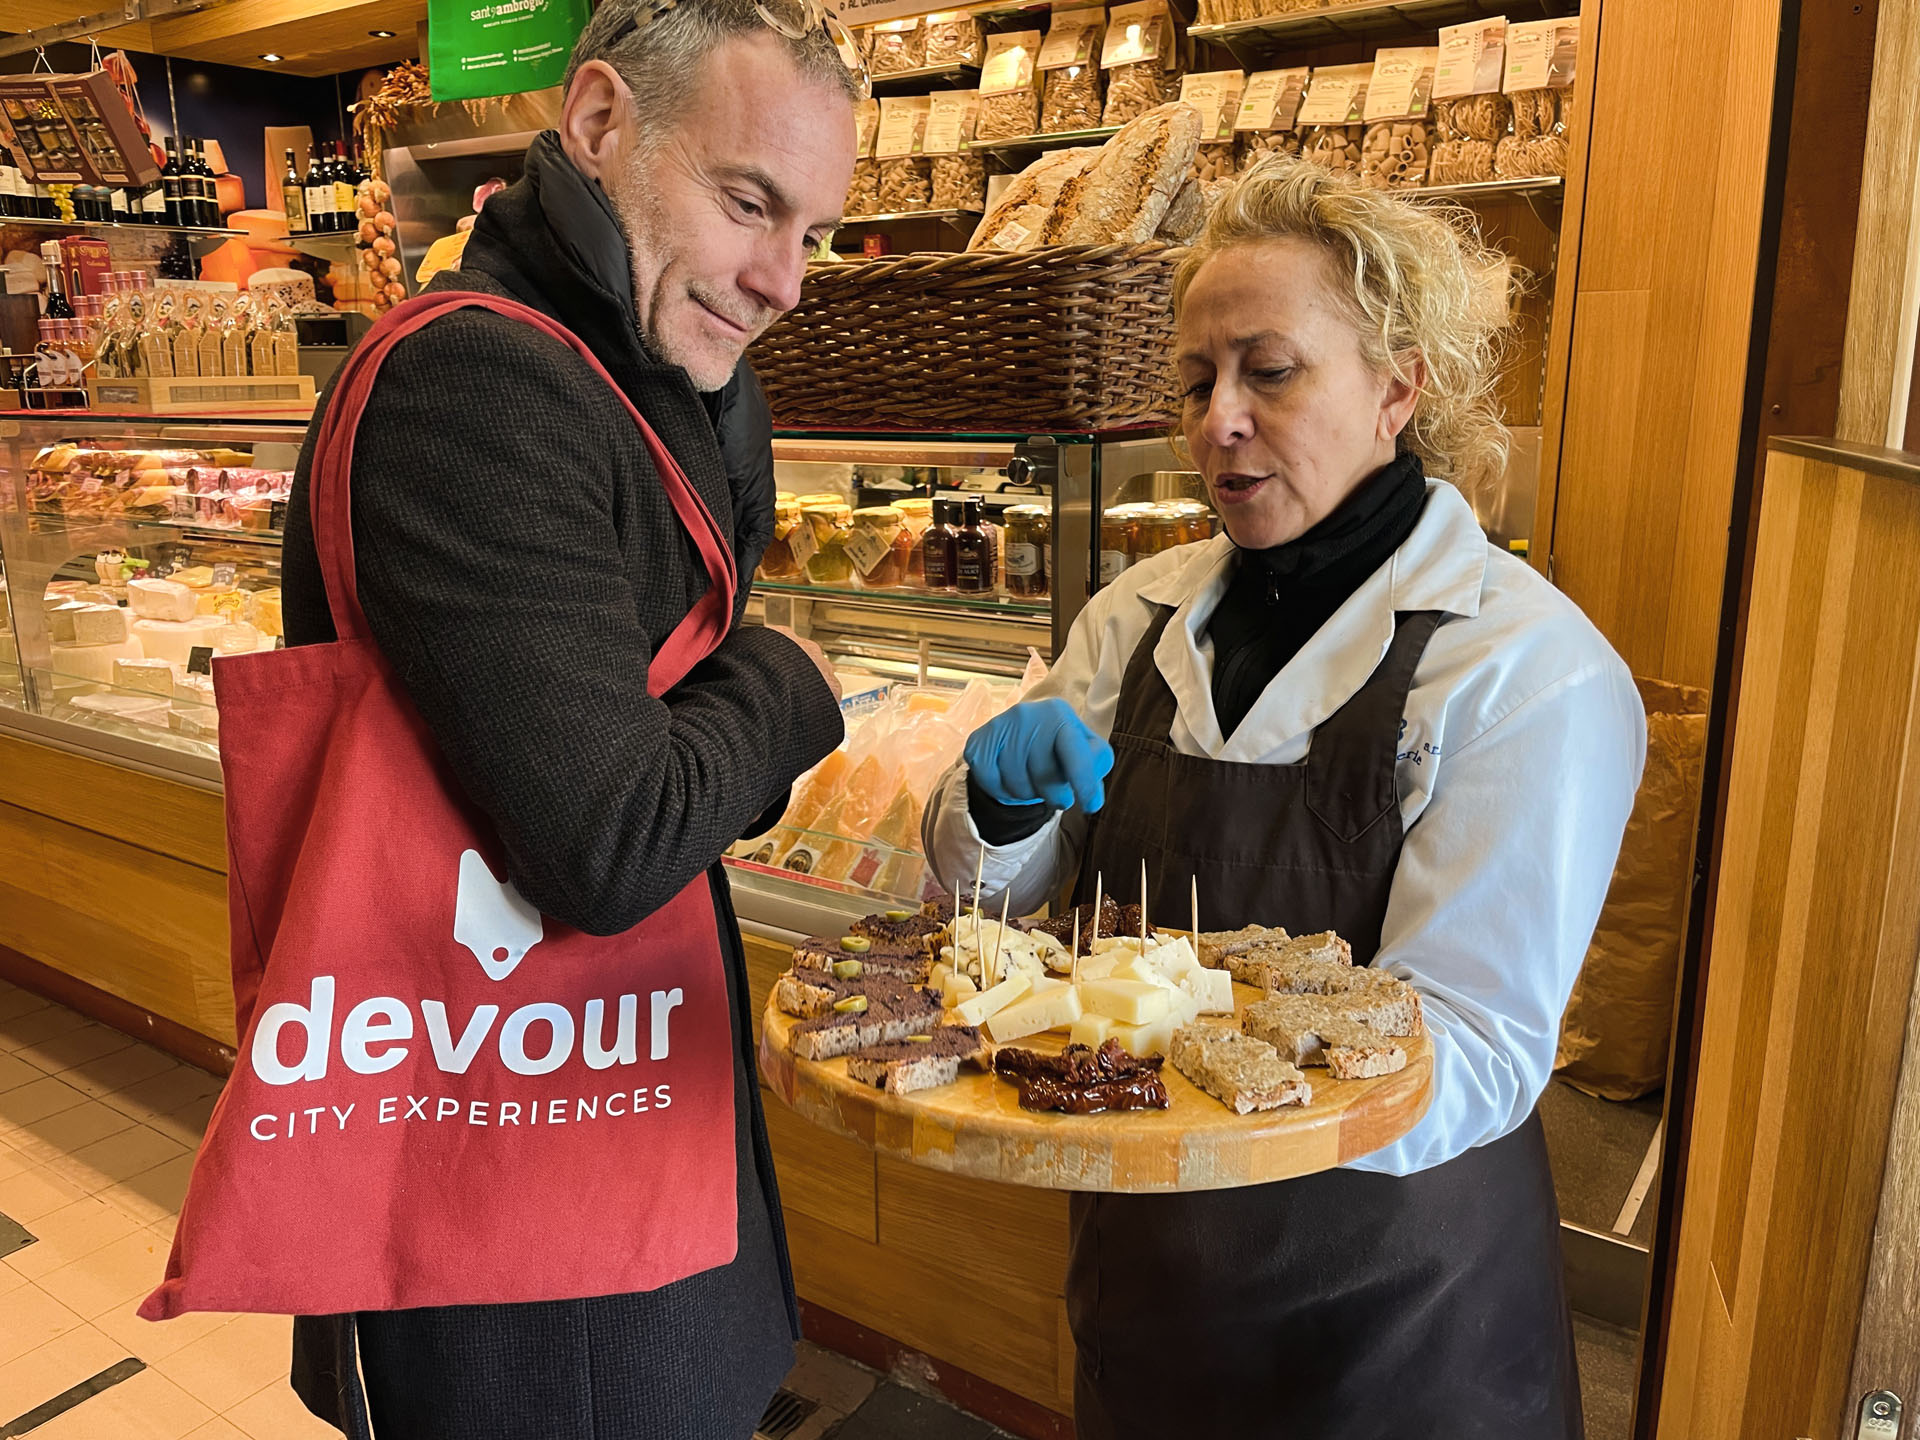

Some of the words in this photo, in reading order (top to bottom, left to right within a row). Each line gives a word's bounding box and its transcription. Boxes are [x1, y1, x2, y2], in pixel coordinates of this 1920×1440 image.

[251, 975, 684, 1085] devour
[250, 1103, 356, 1141] CITY
[378, 1084, 673, 1127] EXPERIENCES
